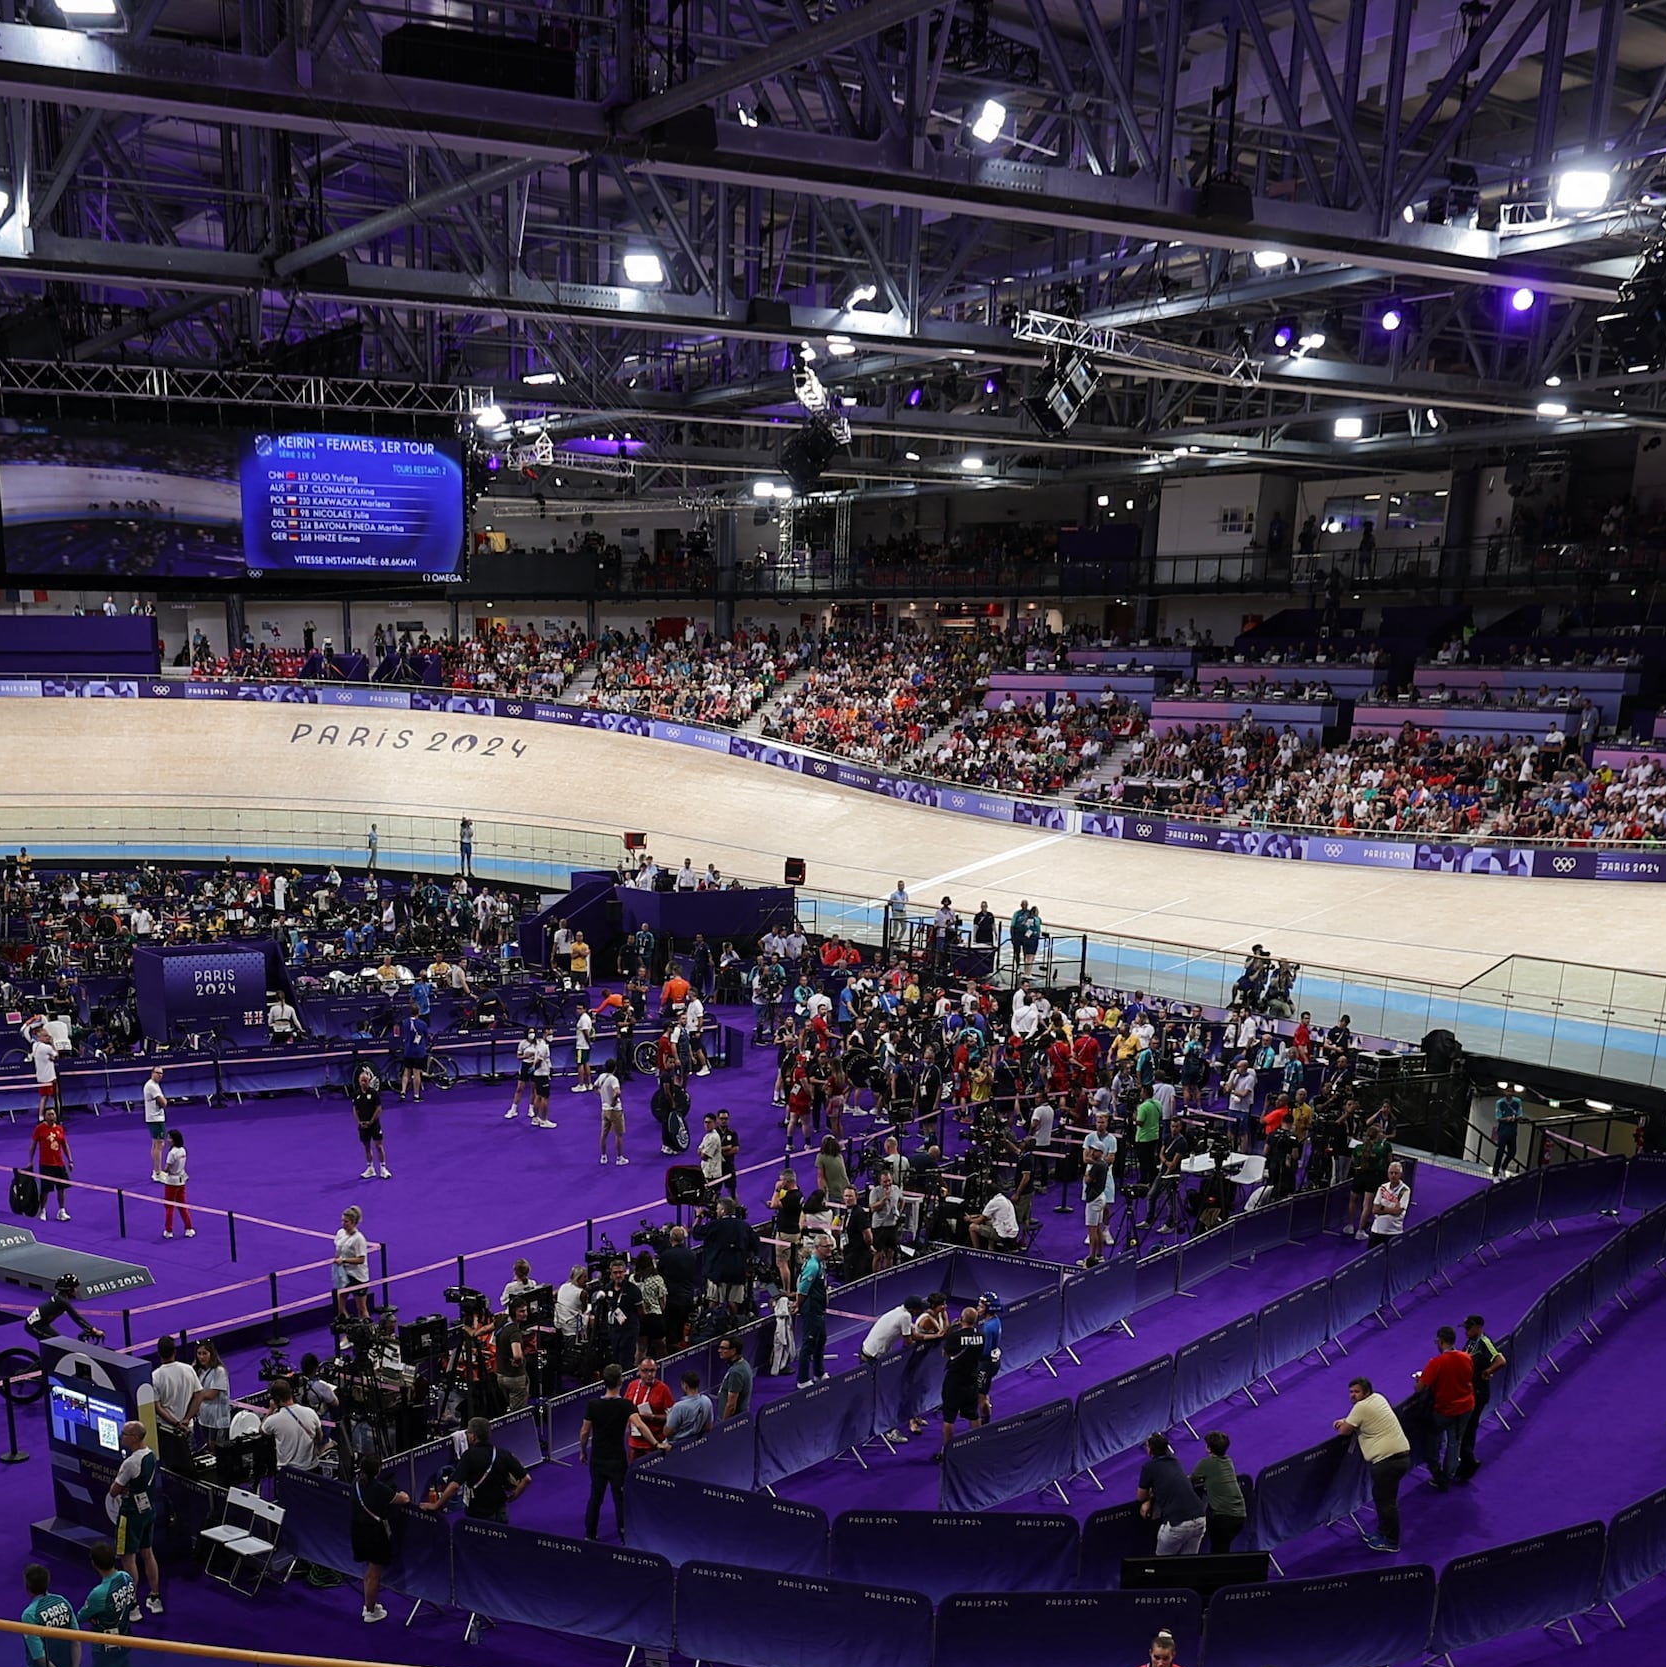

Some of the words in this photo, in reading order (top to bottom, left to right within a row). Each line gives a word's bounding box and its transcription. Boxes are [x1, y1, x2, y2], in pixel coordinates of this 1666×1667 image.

[278, 435, 316, 449] KEIRIN
[326, 440, 377, 454] FEMMES,
[380, 441, 401, 454] 1ER
[403, 442, 434, 455] TOUR
[311, 472, 330, 482] GUO
[331, 473, 358, 484] Yufang
[269, 484, 285, 492] AUS
[299, 484, 309, 493] 87
[311, 485, 346, 494] CLONAN
[347, 486, 375, 496] Kristina
[270, 496, 285, 505] POL
[312, 497, 359, 507] KARWACKA
[360, 499, 390, 509] Marlena
[272, 508, 286, 517] BEL
[312, 509, 353, 519] NICOLAES
[271, 520, 287, 529] COL
[313, 522, 347, 532] BAYONA
[348, 522, 376, 532] PINEDA
[378, 523, 405, 533] Martha
[271, 532, 288, 541] GER
[314, 533, 336, 543] HINZE
[338, 535, 361, 544] Emma
[294, 554, 324, 565] VITESSE
[432, 573, 462, 583] OMEGA
[290, 722, 416, 751] PARIS
[424, 731, 528, 760] 2024
[1363, 848, 1384, 860] PARIS
[1387, 851, 1412, 862] 2024
[1601, 861, 1630, 874] PARIS
[1632, 861, 1660, 875] 2024
[194, 968, 235, 983] PARIS
[195, 983, 236, 997] 2024
[85, 1281, 117, 1295] PARIS
[117, 1274, 145, 1288] 2024
[40, 1602, 67, 1622] PARIS
